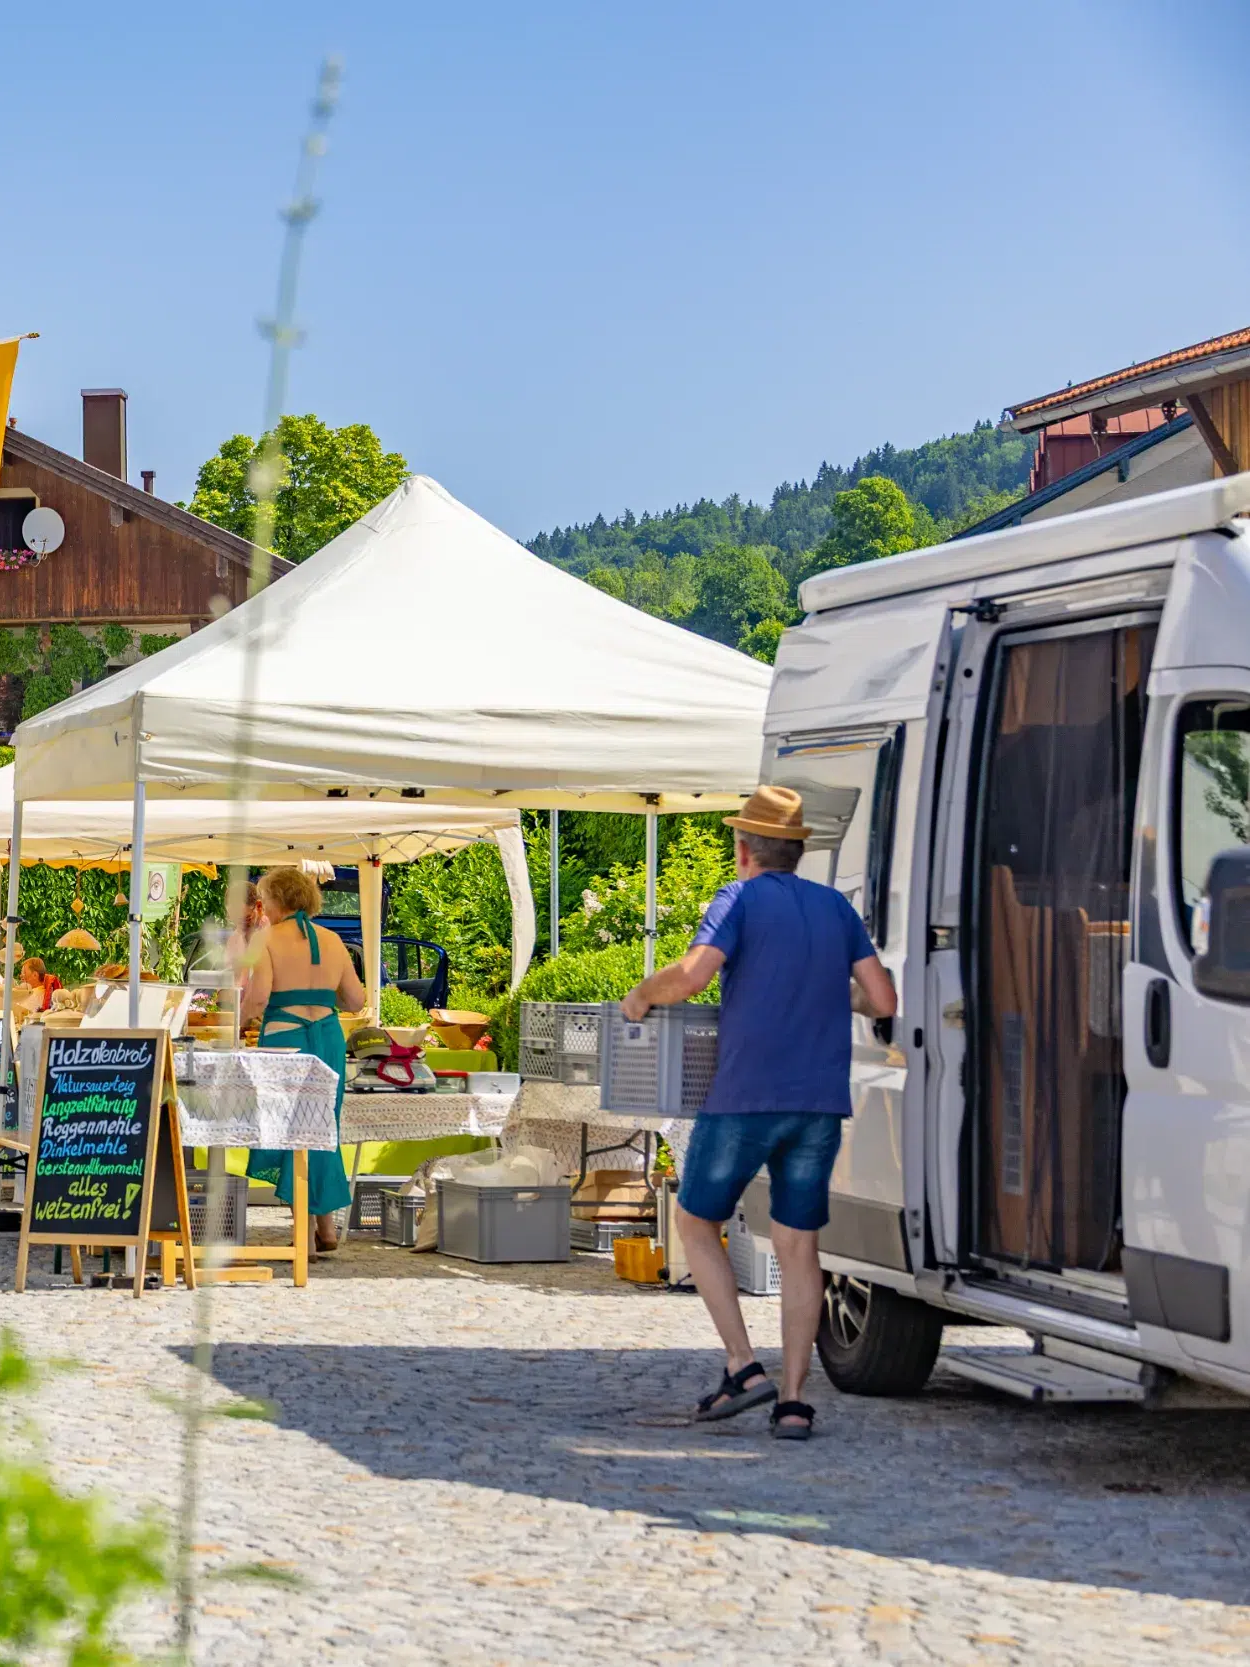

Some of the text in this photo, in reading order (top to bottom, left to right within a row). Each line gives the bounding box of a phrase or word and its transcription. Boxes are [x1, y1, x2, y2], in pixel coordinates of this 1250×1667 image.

[49, 1040, 150, 1067] Holzofenbrot
[52, 1073, 136, 1097] Natursauerteig
[43, 1093, 137, 1121] Langzeitführung
[42, 1116, 142, 1142] Roggenmehle
[40, 1136, 128, 1158] Dinkelmehle
[68, 1175, 108, 1196] alles
